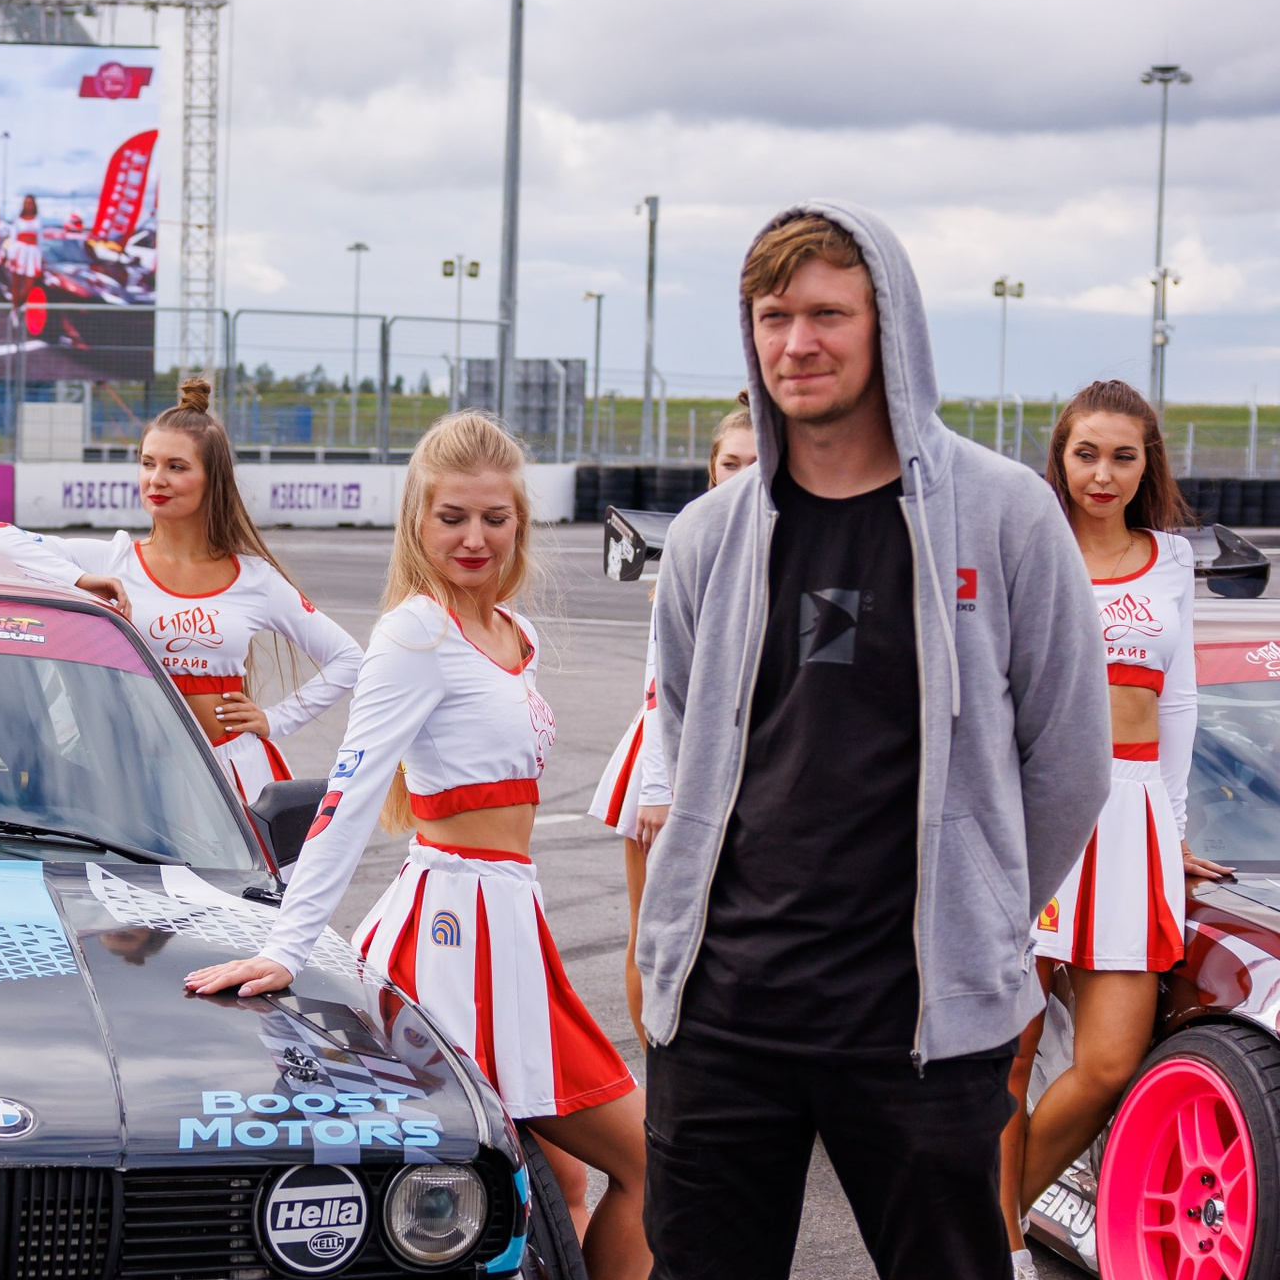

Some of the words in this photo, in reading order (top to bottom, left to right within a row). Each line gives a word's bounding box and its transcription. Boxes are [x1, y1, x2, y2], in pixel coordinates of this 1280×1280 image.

[62, 481, 141, 509] ИЗВЕСТИ
[1107, 646, 1147, 659] РАЙВ
[162, 657, 208, 669] ДРАЙВ
[275, 1199, 359, 1229] Hella
[311, 1237, 344, 1249] HELLA
